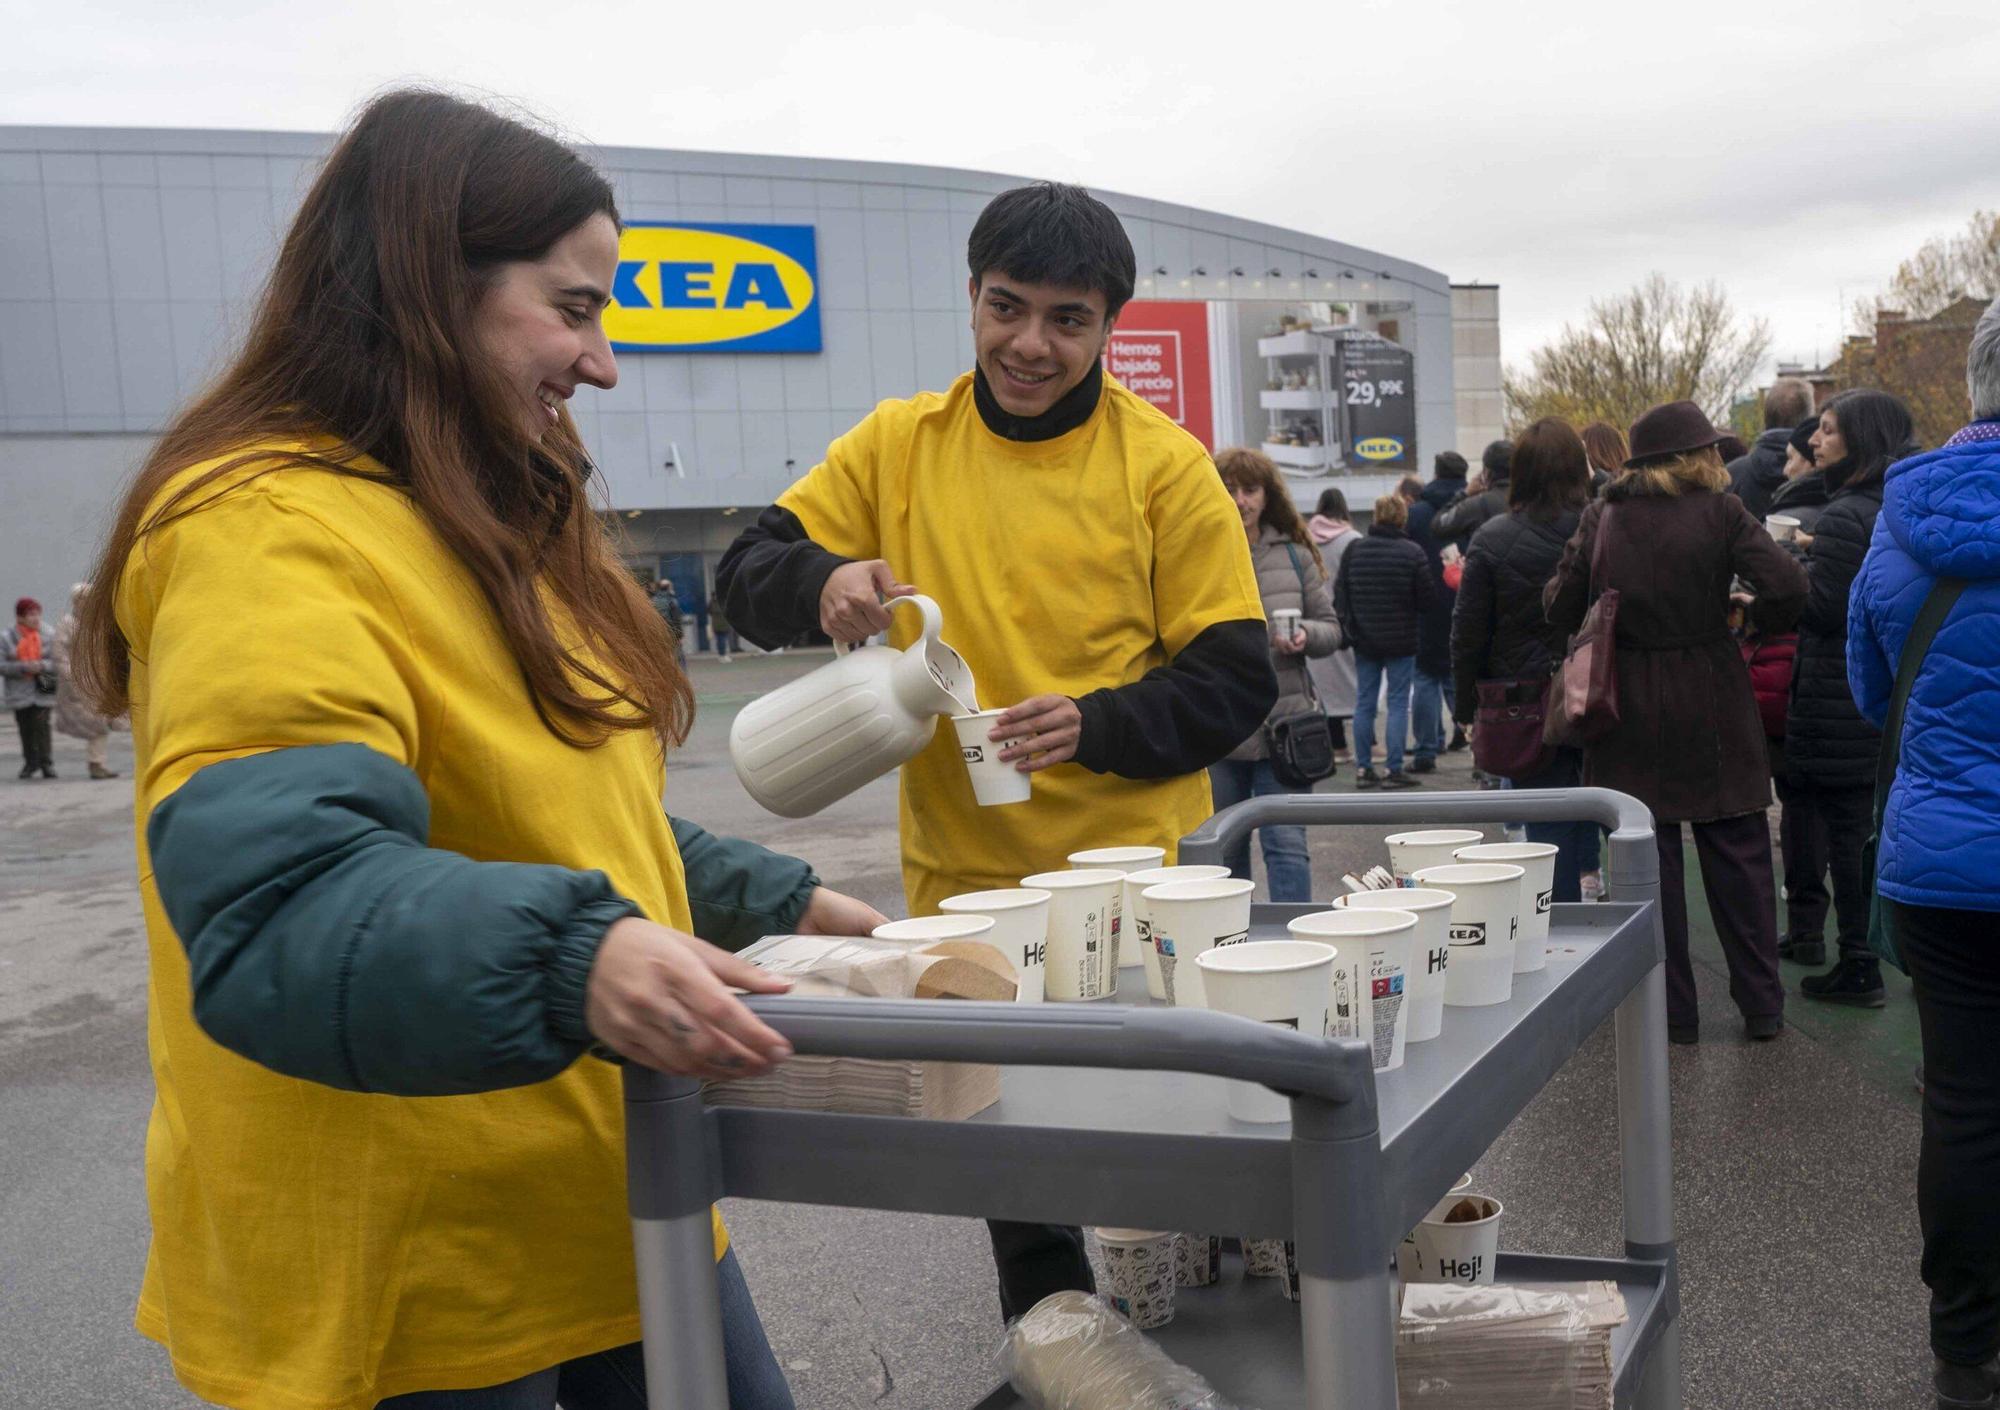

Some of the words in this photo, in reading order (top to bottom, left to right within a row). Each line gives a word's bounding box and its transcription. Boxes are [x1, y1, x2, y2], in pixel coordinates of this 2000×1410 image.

[611, 261, 794, 309] KEA
[1111, 341, 1163, 357] Hemos
[1112, 357, 1162, 376] bajado
[1129, 375, 1174, 393] precio
[1360, 444, 1398, 453] IKEA
[1449, 929, 1481, 940] KEA
[1428, 947, 1448, 975] He
[1440, 1255, 1482, 1283] Hej!
